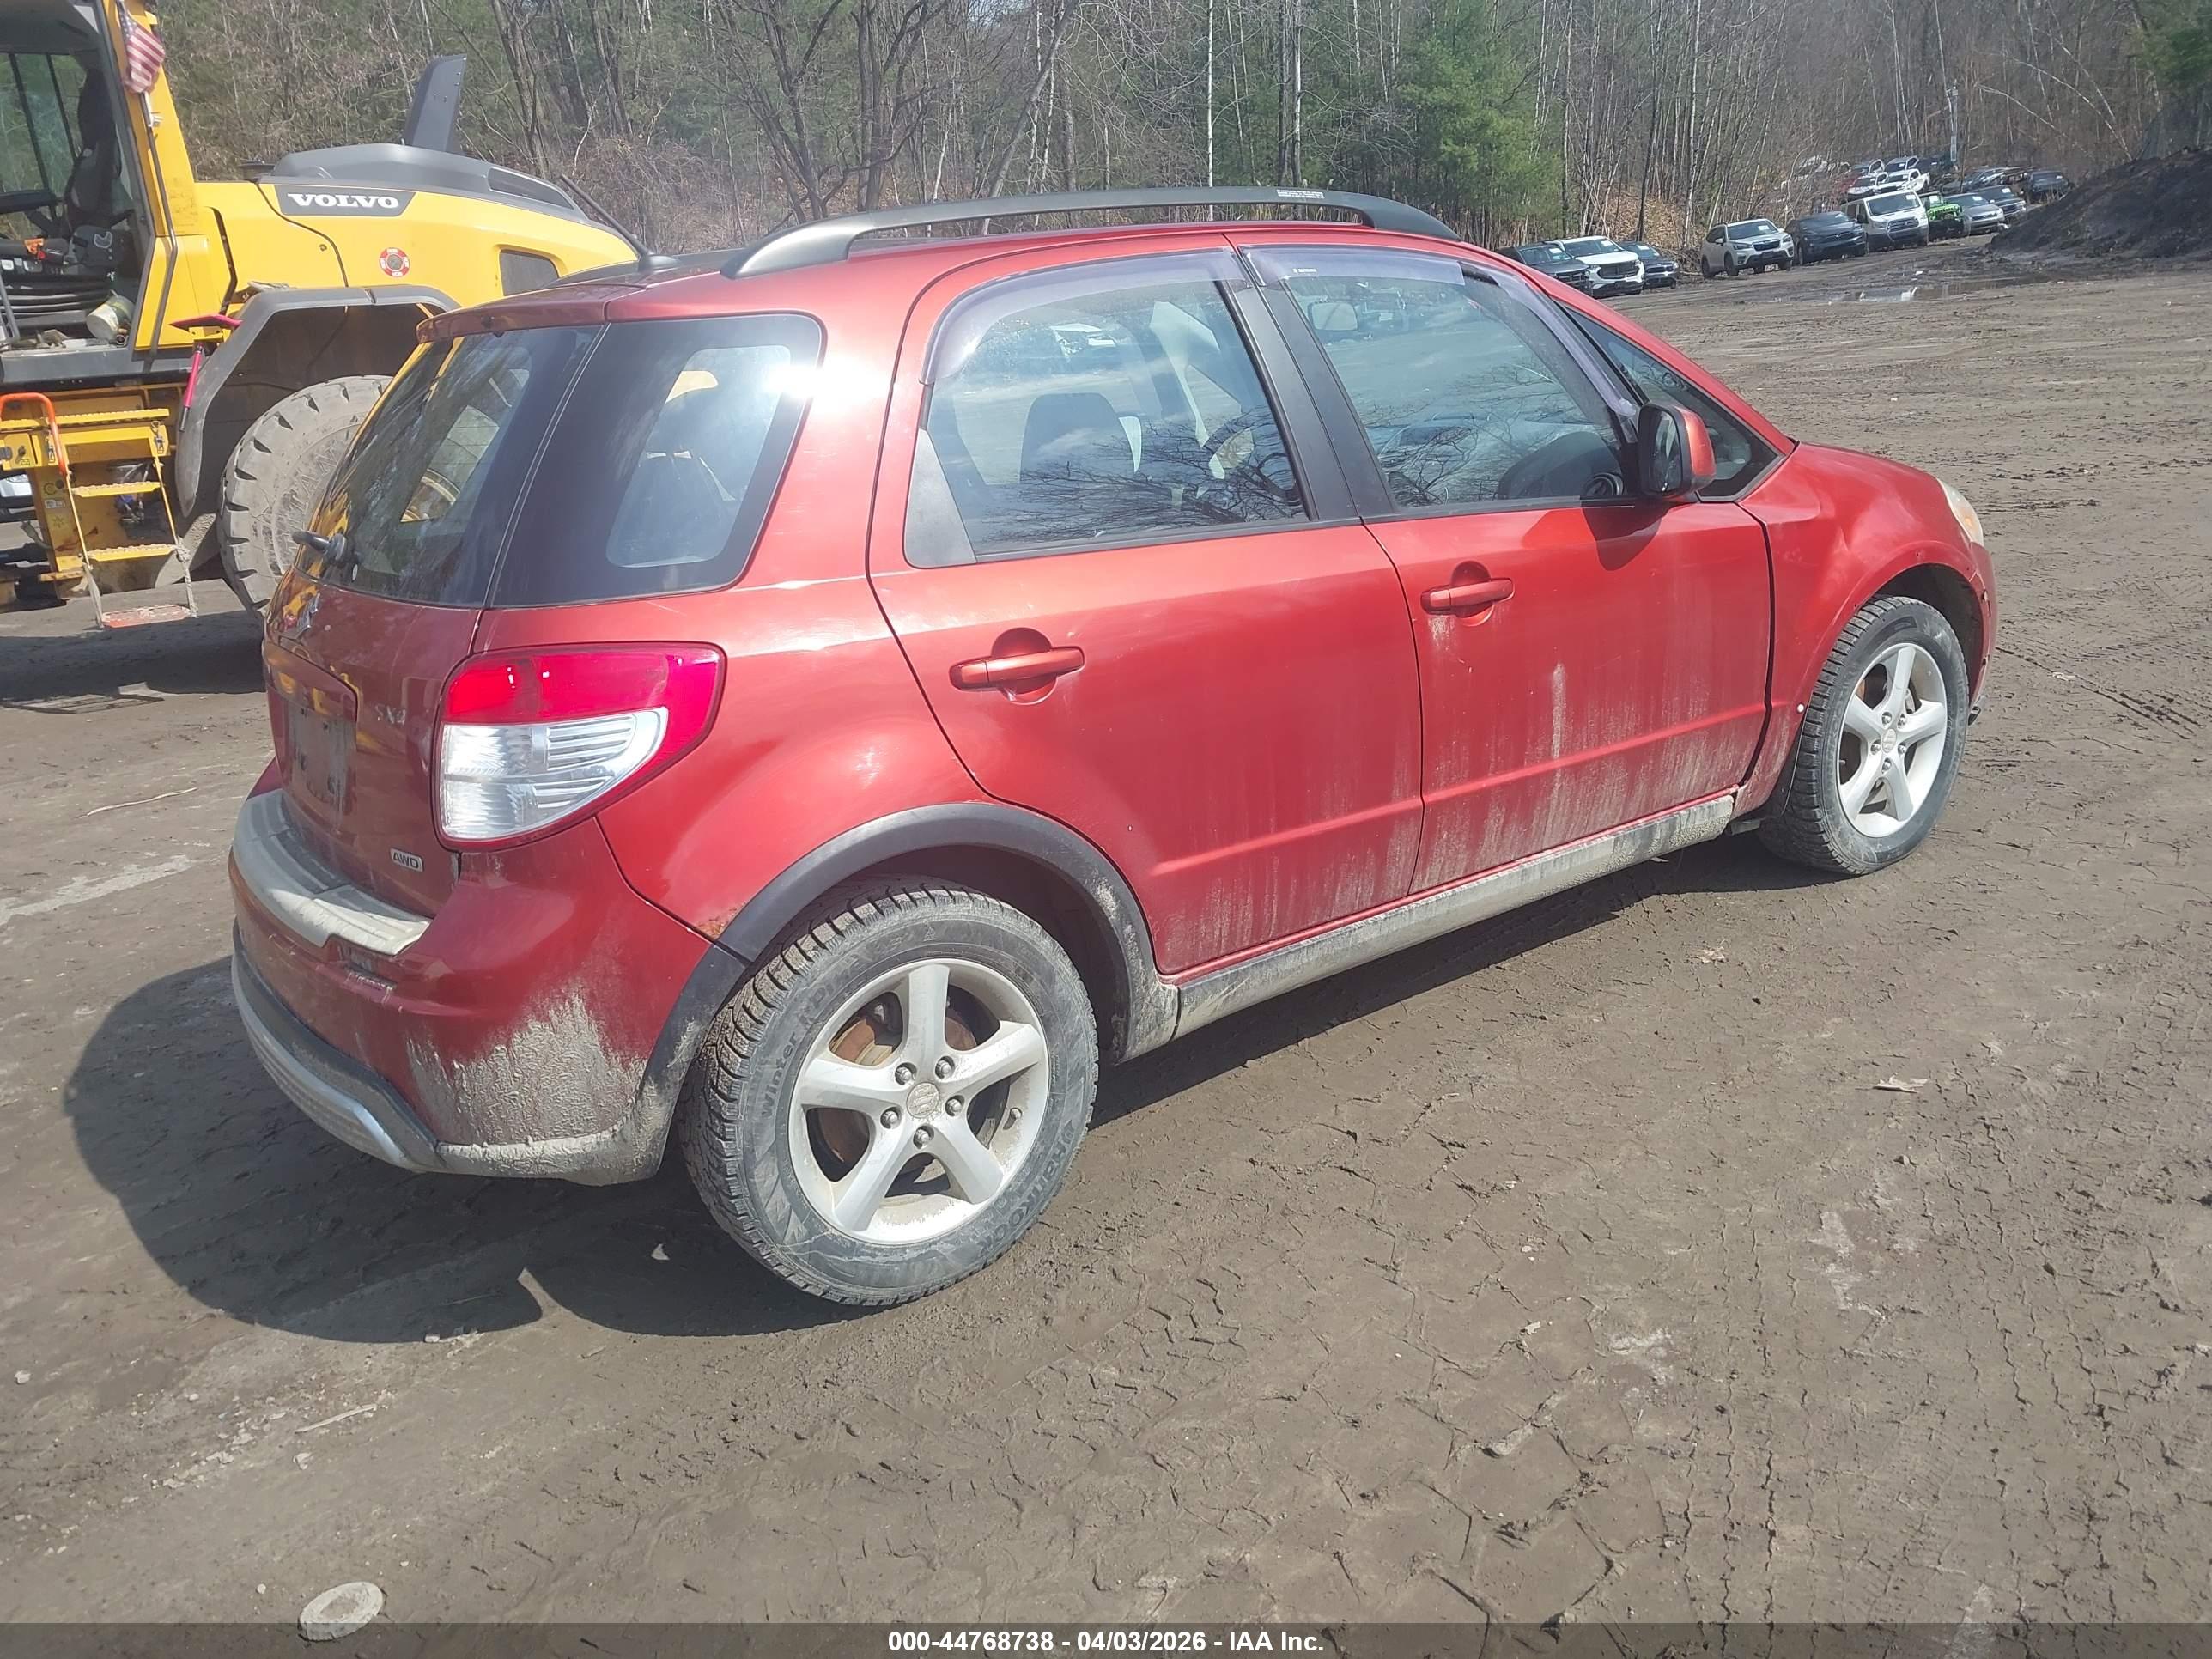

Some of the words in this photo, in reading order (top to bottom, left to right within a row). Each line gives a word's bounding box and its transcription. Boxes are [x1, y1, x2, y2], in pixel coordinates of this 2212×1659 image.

[287, 193, 399, 209] VOLVO
[392, 852, 419, 868] AWD
[761, 1030, 801, 1117] Winter
